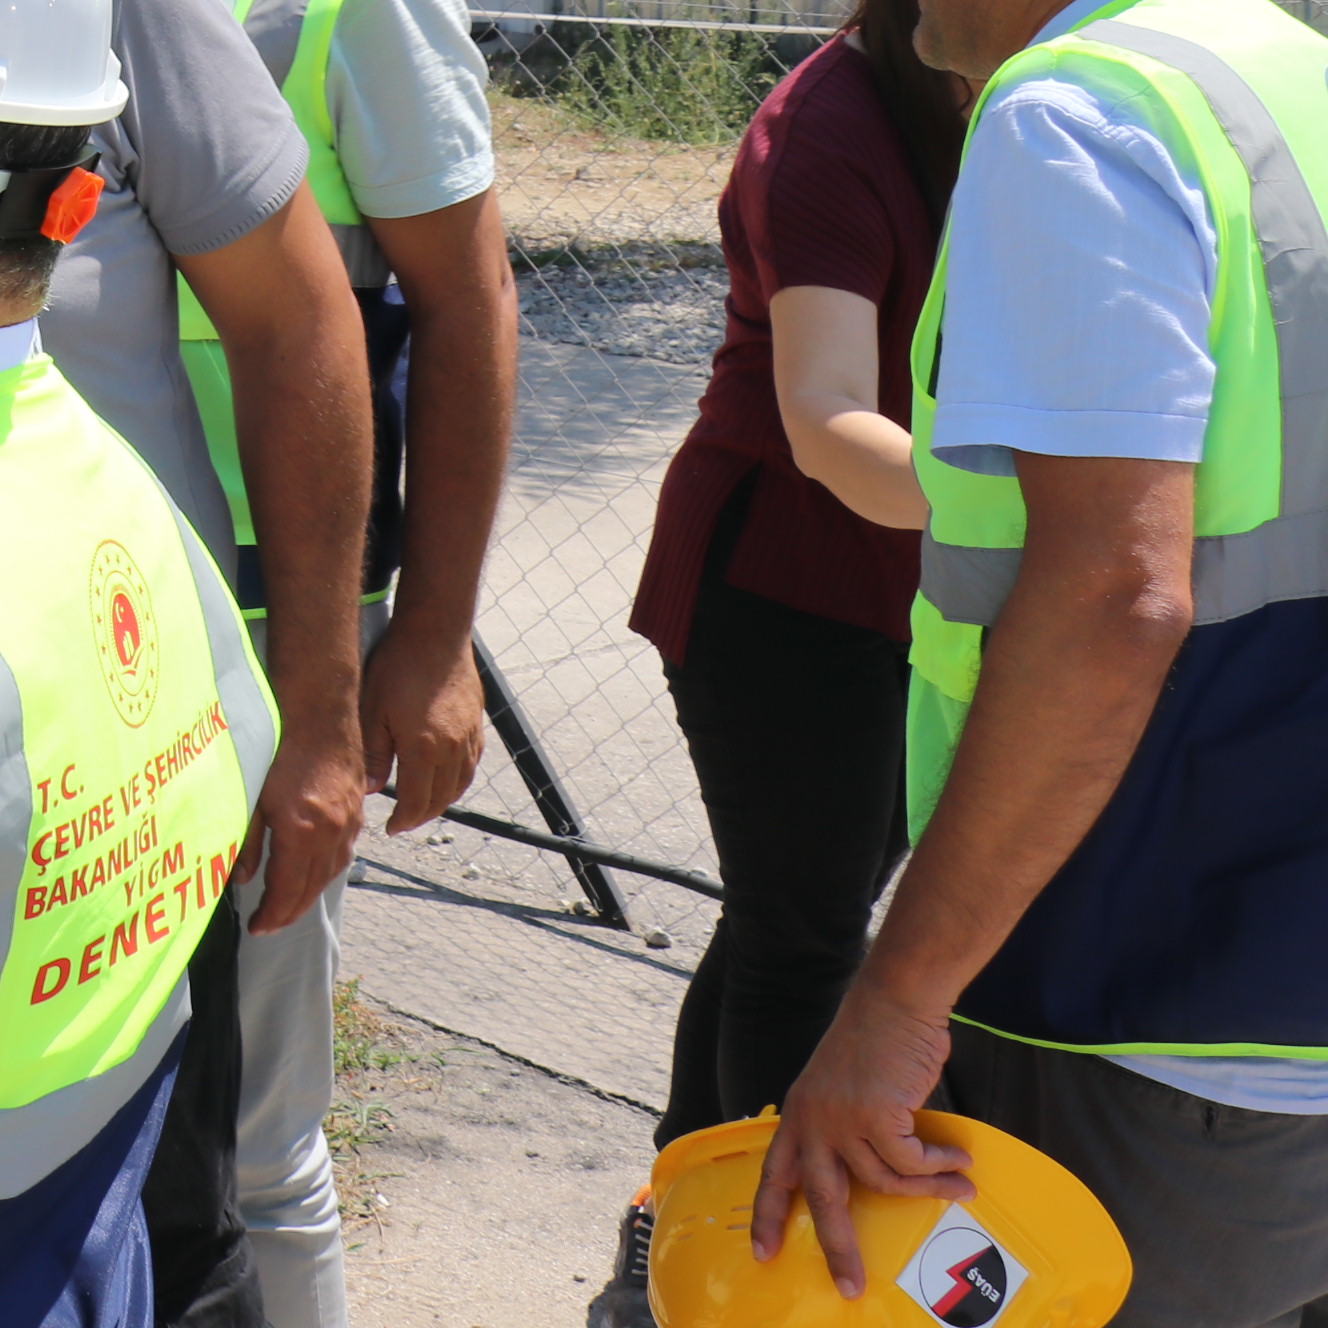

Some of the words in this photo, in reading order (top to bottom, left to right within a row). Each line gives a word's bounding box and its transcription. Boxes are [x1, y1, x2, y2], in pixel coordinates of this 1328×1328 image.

[31, 794, 115, 876] ÇEVRE
[120, 772, 141, 817] VE
[144, 700, 229, 805] ŞEHİRCİLİK
[24, 811, 159, 920] BAKANLIĞI
[124, 841, 185, 907] YİGM
[30, 840, 238, 1006] DENETİM
[966, 1266, 1001, 1303] EÜAŞ
